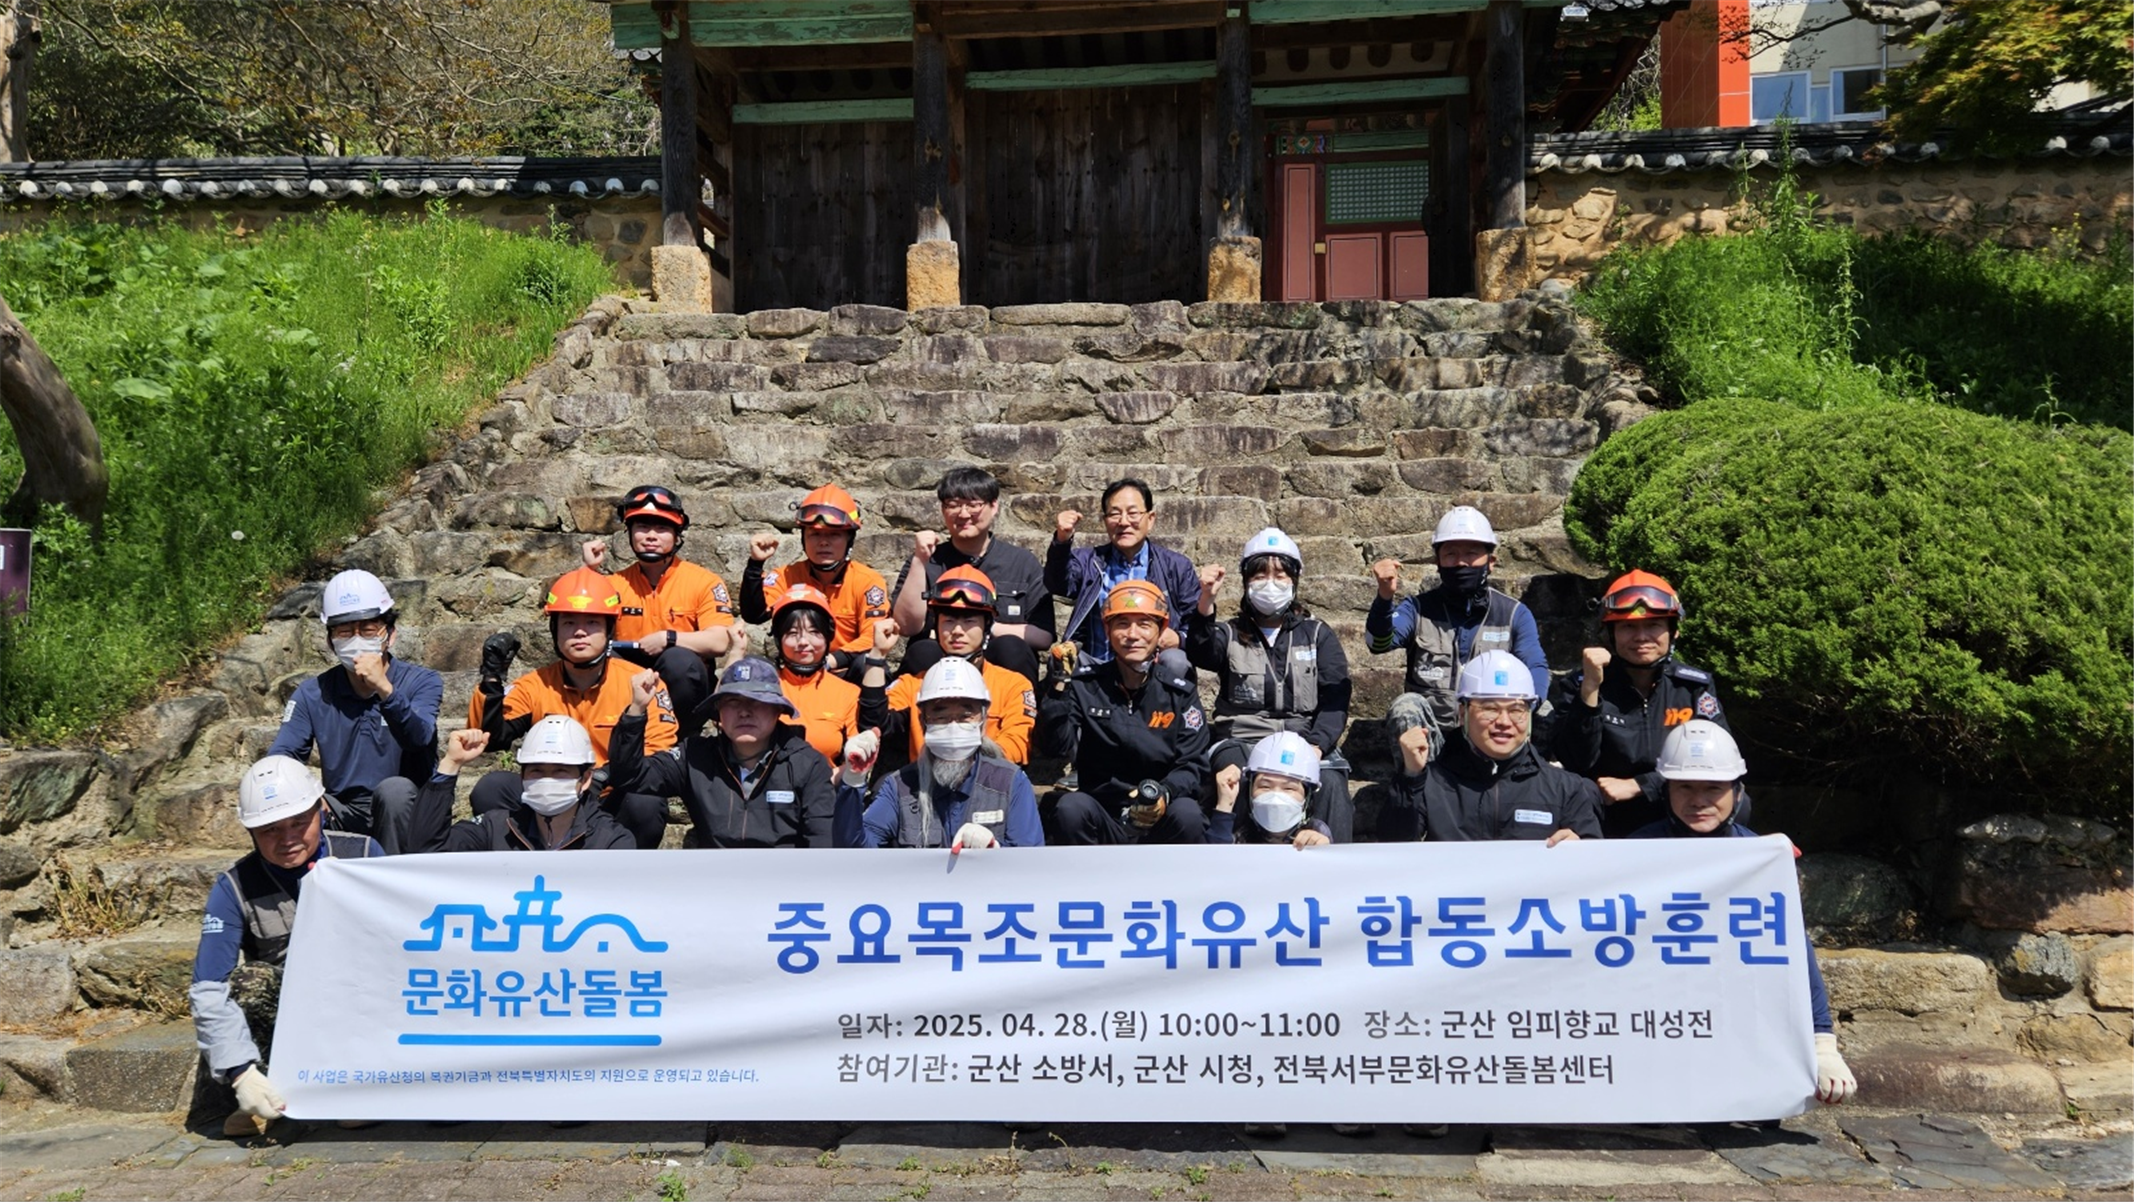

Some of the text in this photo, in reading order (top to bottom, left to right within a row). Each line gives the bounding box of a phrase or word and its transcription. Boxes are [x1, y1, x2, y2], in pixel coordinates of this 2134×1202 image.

[1148, 710, 1175, 729] 119
[1664, 706, 1693, 727] 119
[767, 891, 1790, 975] 중요목조문화유산 합동소방훈련
[401, 967, 669, 1019] 문화유산돌봄
[837, 1009, 1341, 1043] 일자: 2025. 04. 28.(월) 10:00~11:00
[1363, 1008, 1714, 1040] 장소: 군산 임피향교 대성전
[298, 1069, 759, 1085] 이 사업은 국가유산청의 복권기금과 전북특별자치도의 지원으로 운영되고 있습니다.
[836, 1052, 1614, 1089] 참여기관: 군산 소방서, 군산 시청, 전북서부문화유산돌봄센터
